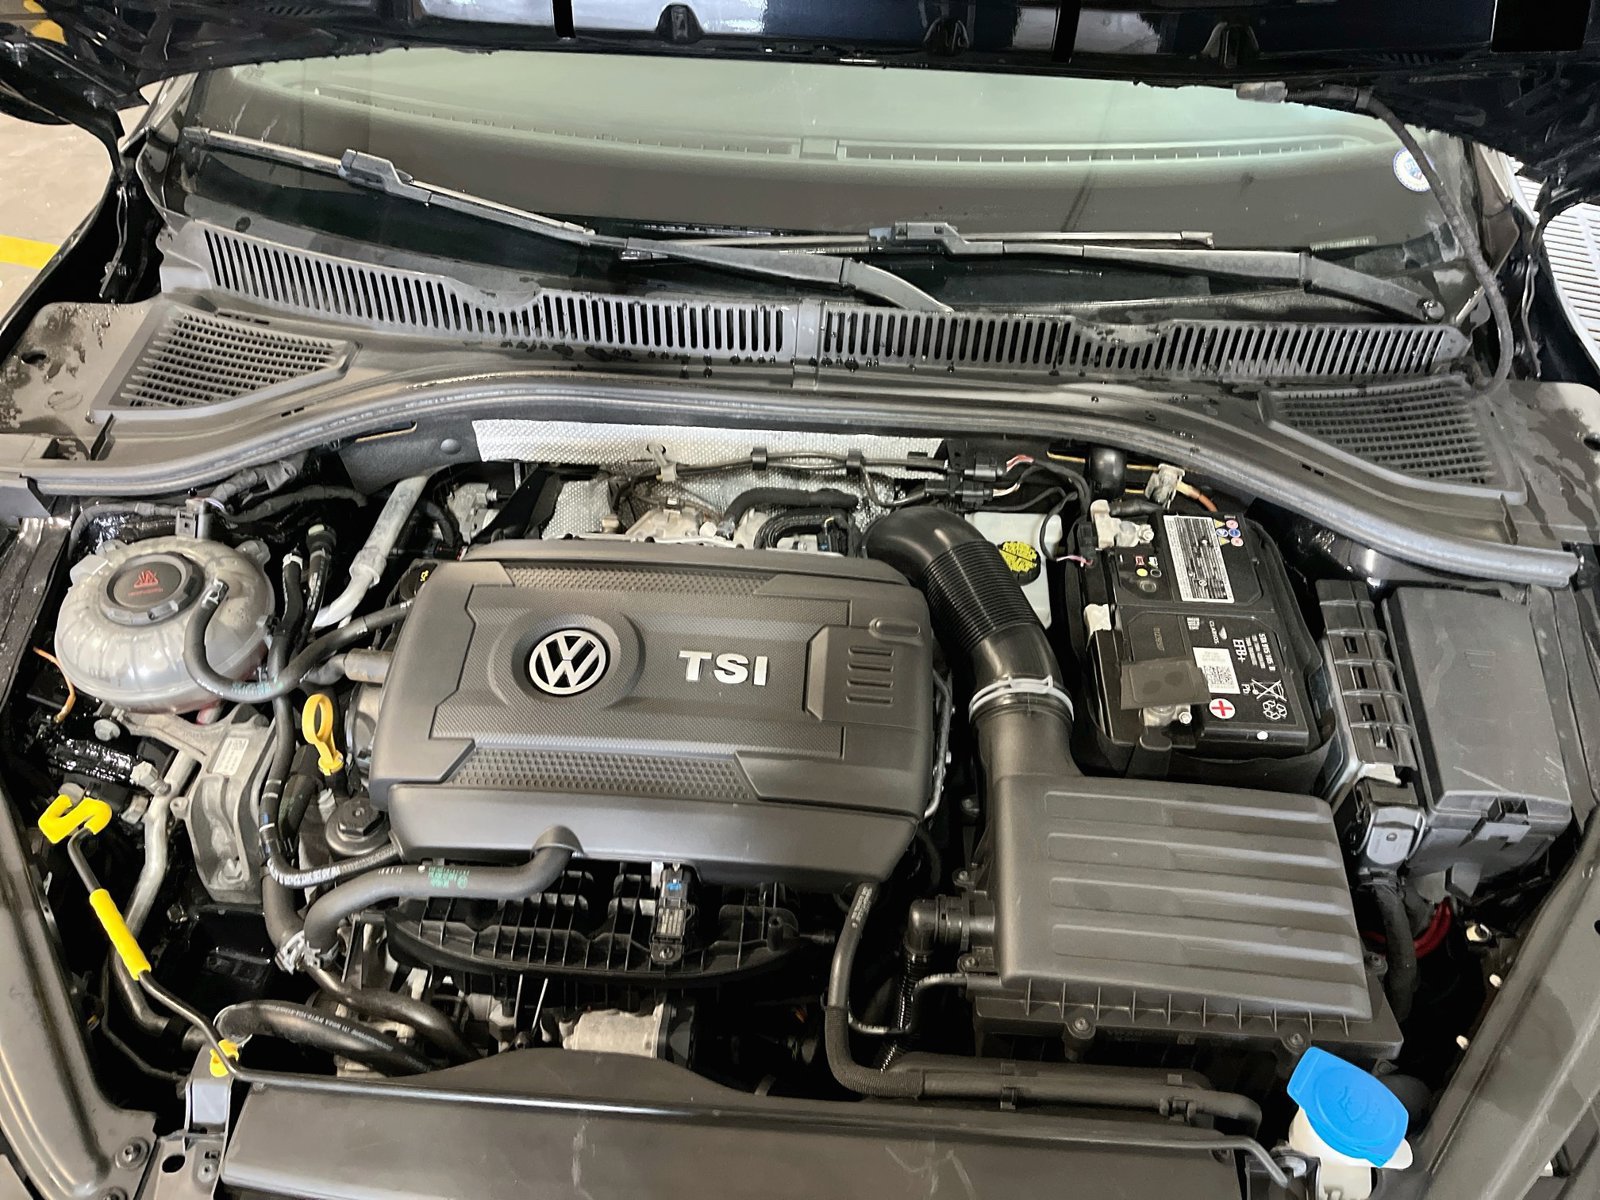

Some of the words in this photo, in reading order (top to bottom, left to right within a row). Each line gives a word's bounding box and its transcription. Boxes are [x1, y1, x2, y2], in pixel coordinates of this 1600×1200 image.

[529, 630, 607, 695] VW
[679, 650, 768, 687] TSI
[1233, 639, 1248, 663] EFB+
